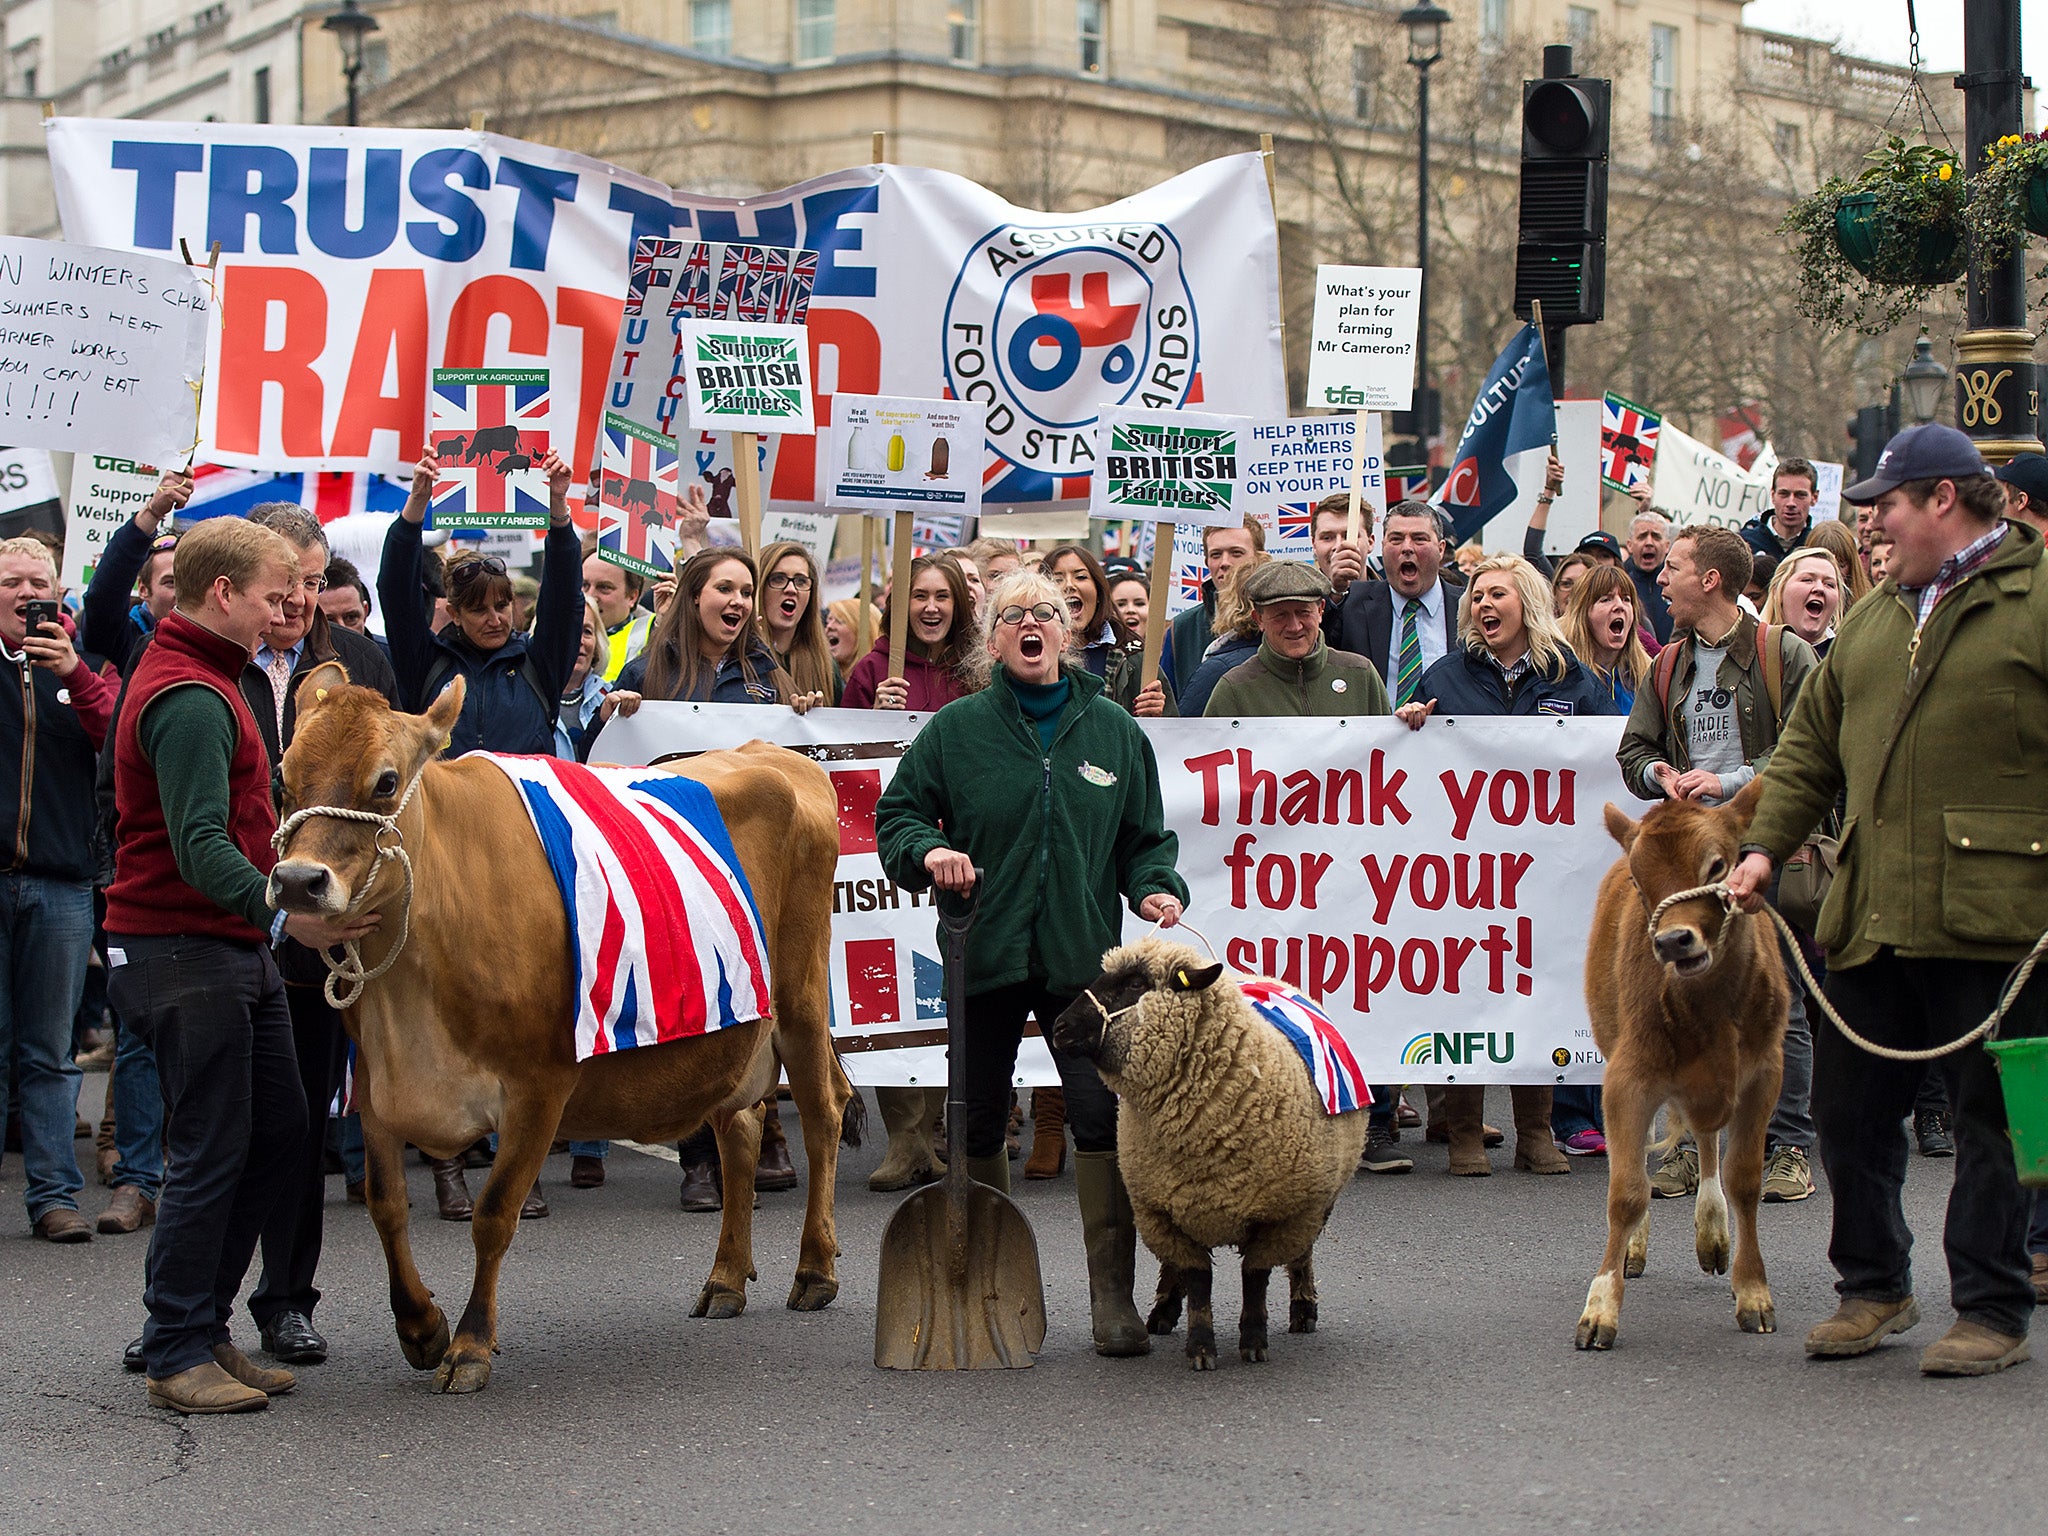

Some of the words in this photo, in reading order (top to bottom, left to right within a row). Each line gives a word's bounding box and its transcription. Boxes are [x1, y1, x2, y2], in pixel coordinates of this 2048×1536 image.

[111, 140, 579, 271] TRUST
[986, 226, 1165, 277] ASSURED
[49, 257, 149, 294] WINTERS
[623, 239, 820, 325] FARM
[1326, 284, 1375, 298] What's
[1378, 289, 1411, 301] your
[1, 300, 89, 318] SUMMERS
[109, 312, 162, 334] HEAT
[1339, 304, 1369, 318] plan
[1374, 304, 1395, 316] for
[1338, 322, 1393, 338] farming
[0, 328, 55, 348] ARMER
[72, 339, 129, 365] WORKS
[709, 338, 786, 360] Support
[1317, 341, 1338, 352] Mr
[1341, 342, 1411, 355] Cameron?
[43, 367, 92, 382] CAN
[104, 375, 140, 396] EAT
[437, 373, 475, 381] SUPPORT
[489, 374, 545, 382] AGRICULTURE
[696, 363, 803, 389] BRITISH
[953, 323, 1015, 436] FOOD
[1022, 305, 1188, 464] STAARDS
[713, 392, 791, 412] Farmers
[1324, 385, 1365, 405] tfa
[1364, 399, 1398, 407] Association
[851, 408, 859, 416] We
[859, 416, 869, 424] this
[949, 414, 960, 422] they
[607, 416, 632, 432] SUPPORT
[632, 427, 640, 436] UK
[640, 431, 677, 451] AGRICULTURE
[1127, 428, 1223, 452] Support
[1253, 426, 1297, 440] HELP
[1302, 421, 1365, 438] BRITIS
[1271, 440, 1352, 456] FARMERS
[1106, 456, 1238, 480] BRITISH
[1248, 462, 1289, 476] KEEP
[1295, 460, 1329, 473] THE
[1332, 456, 1380, 472] FOD
[1121, 482, 1218, 506] Farmers
[1246, 480, 1271, 494] ON
[1276, 477, 1324, 492] YOUR
[1329, 474, 1381, 490] PLTE
[1695, 476, 1731, 509] NO
[76, 505, 124, 523] Welsh
[436, 517, 463, 526] MOLE
[464, 517, 499, 526] VALLEY
[500, 517, 546, 526] FARMERS
[600, 549, 618, 562] MOLE
[618, 555, 641, 571] VALLEY
[1692, 715, 1729, 733] INDIE
[1692, 730, 1729, 744] FARMER
[1183, 748, 1412, 826] Thank
[1439, 769, 1577, 841] you
[1223, 833, 1334, 910] for
[1360, 853, 1535, 925] your
[833, 879, 899, 914] TISH
[1226, 916, 1533, 1014] support!
[1574, 1029, 1592, 1038] NFU
[1433, 1032, 1515, 1065] NFU
[1575, 1051, 1604, 1064] NFU
